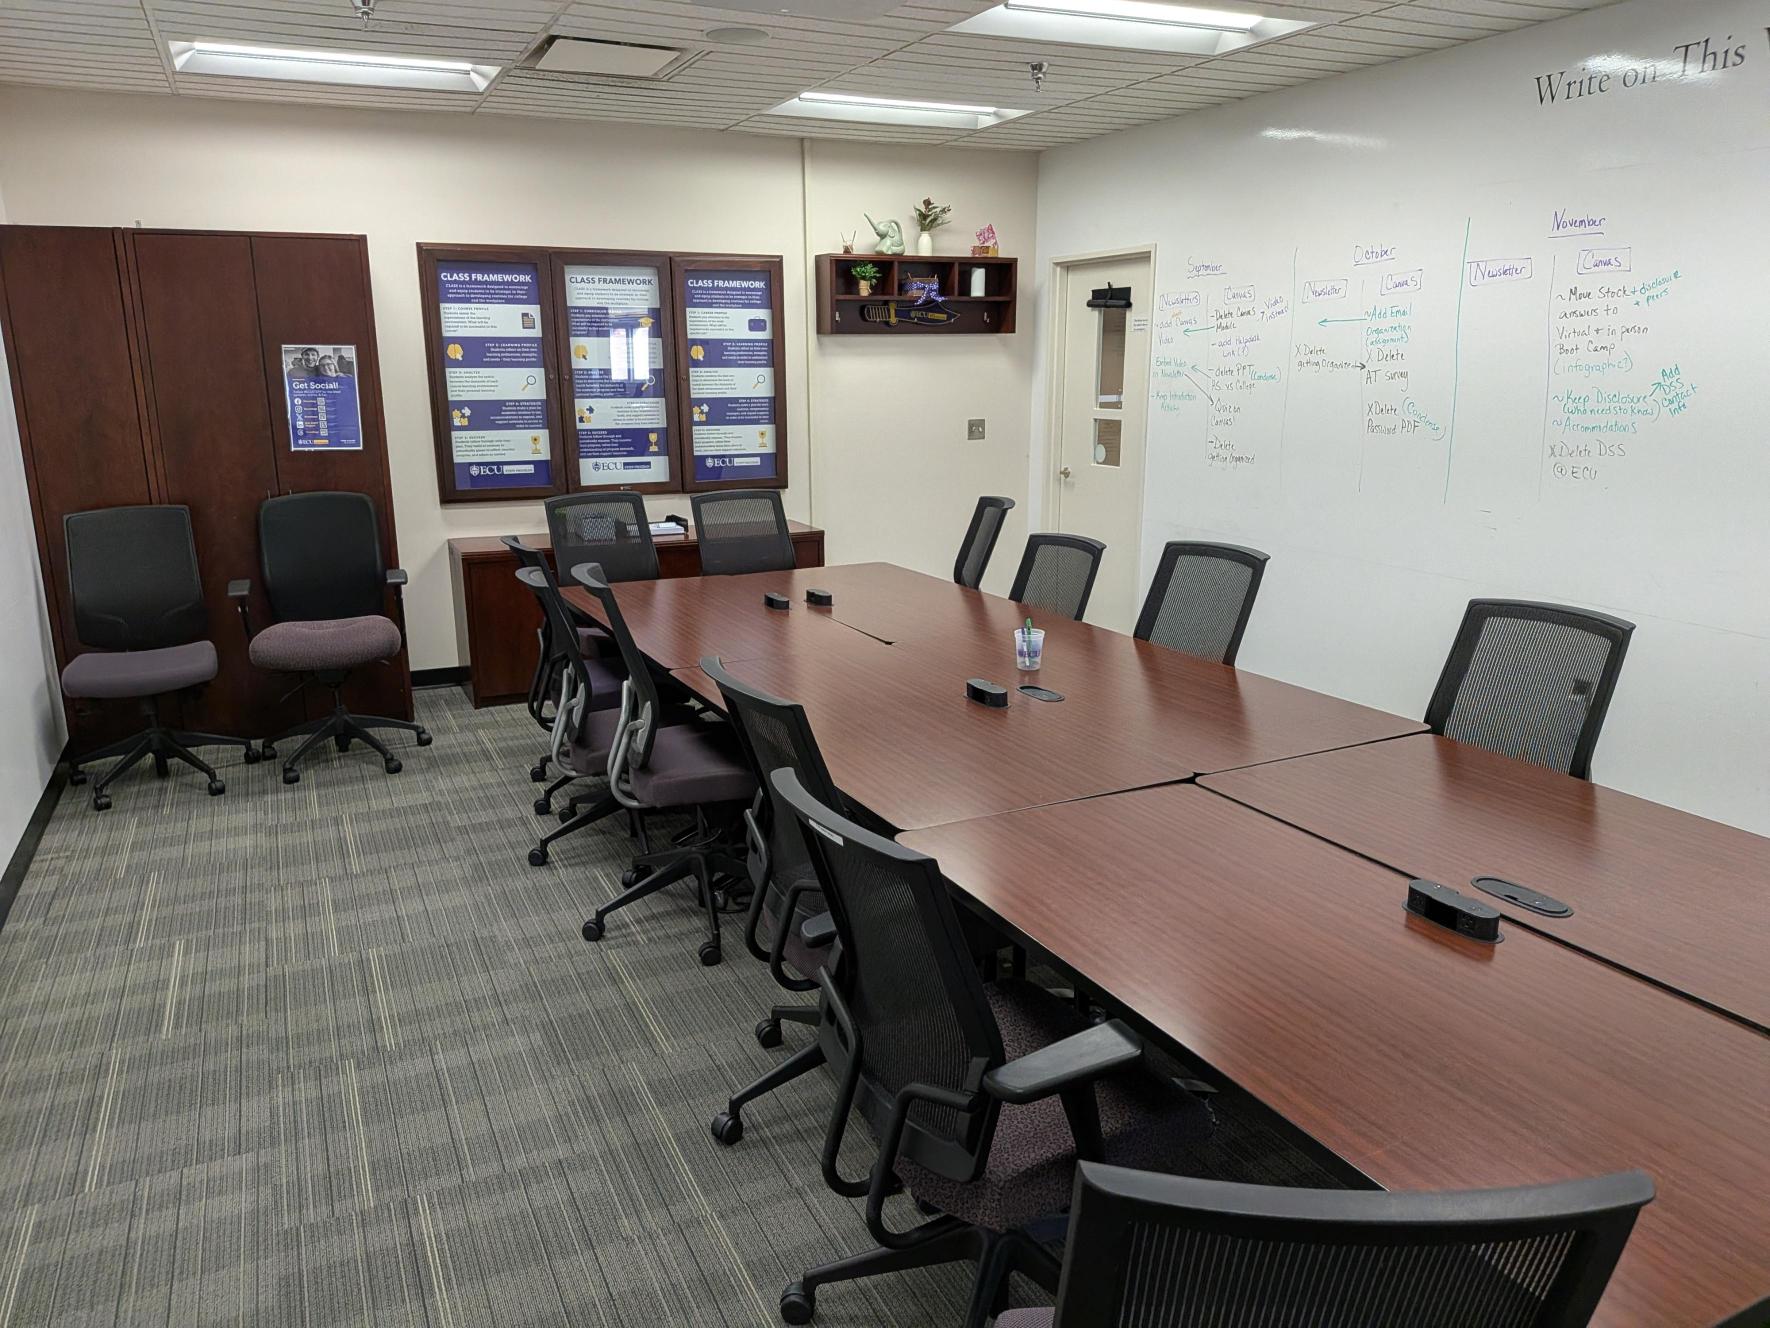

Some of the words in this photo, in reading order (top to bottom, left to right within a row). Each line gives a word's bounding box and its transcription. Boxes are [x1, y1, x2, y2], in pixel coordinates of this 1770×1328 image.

[1534, 68, 1611, 107] Write
[1622, 66, 1658, 88] on
[1673, 35, 1746, 78] This
[1552, 208, 1606, 231] November
[1354, 243, 1397, 263] October
[1583, 250, 1622, 270] Canvas
[1187, 256, 1222, 277] September
[1474, 260, 1526, 280] Newsletter
[441, 272, 469, 281] CLASS
[472, 273, 532, 283] FRAMEWORK
[570, 276, 595, 284] CLASS
[598, 277, 654, 286] FRAMEWORK
[688, 279, 712, 287] CLASS
[715, 280, 766, 289] FRAMEWORK
[1386, 273, 1418, 291] Canvas
[1568, 286, 1592, 302] Move
[1598, 285, 1631, 300] Stock
[1639, 270, 1682, 295] disclosure
[1226, 286, 1252, 300] Canvas
[1306, 281, 1342, 300] Newsletter
[1646, 288, 1669, 307] peers
[1370, 304, 1387, 321] Add
[1390, 301, 1413, 318] Email
[1558, 307, 1599, 320] answers
[1603, 304, 1618, 317] to
[1556, 325, 1591, 340] Virtual
[1607, 326, 1617, 337] in
[1620, 325, 1649, 342] person
[1303, 343, 1327, 356] Delete
[1376, 347, 1406, 362] Delete
[1556, 343, 1580, 355] Boot
[1586, 340, 1616, 357] Camp
[1236, 362, 1255, 377] PPT
[1365, 368, 1382, 385] AT
[1661, 363, 1681, 381] Add
[310, 381, 339, 389] Social!
[1661, 377, 1685, 396] DSS
[1565, 389, 1590, 408] Keep
[1592, 386, 1649, 405] Disclosure
[1374, 400, 1398, 416] Delete
[1400, 418, 1421, 436] PDF
[1559, 440, 1593, 458] Delete
[1595, 439, 1626, 457] DSS
[481, 465, 503, 475] ECU
[601, 461, 622, 470] ECU
[715, 458, 733, 467] ECU
